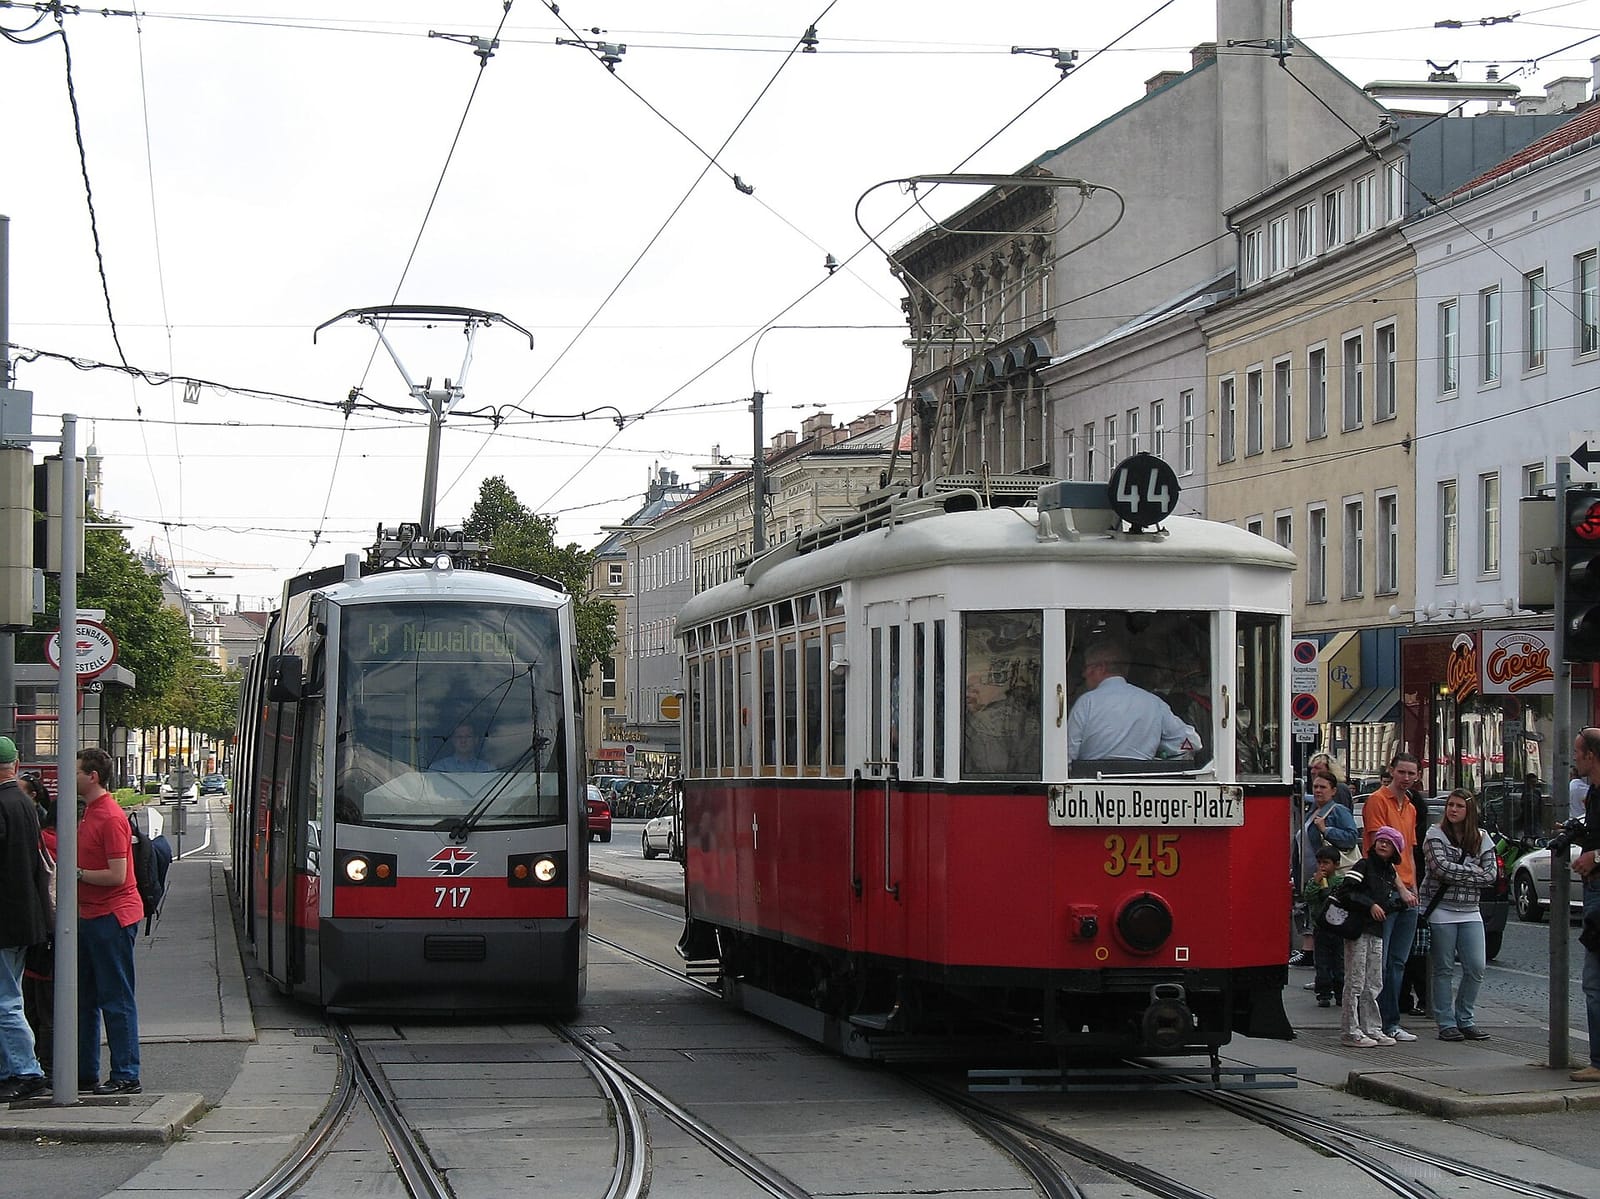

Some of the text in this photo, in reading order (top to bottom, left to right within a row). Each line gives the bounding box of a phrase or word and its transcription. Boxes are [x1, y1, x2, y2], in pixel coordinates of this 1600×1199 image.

[1117, 468, 1170, 513] 44
[368, 623, 517, 657] 43 Neuwaldegg
[1487, 643, 1553, 688] Geier
[90, 683, 102, 691] 43
[1104, 834, 1179, 877] 345
[434, 886, 471, 908] 717
